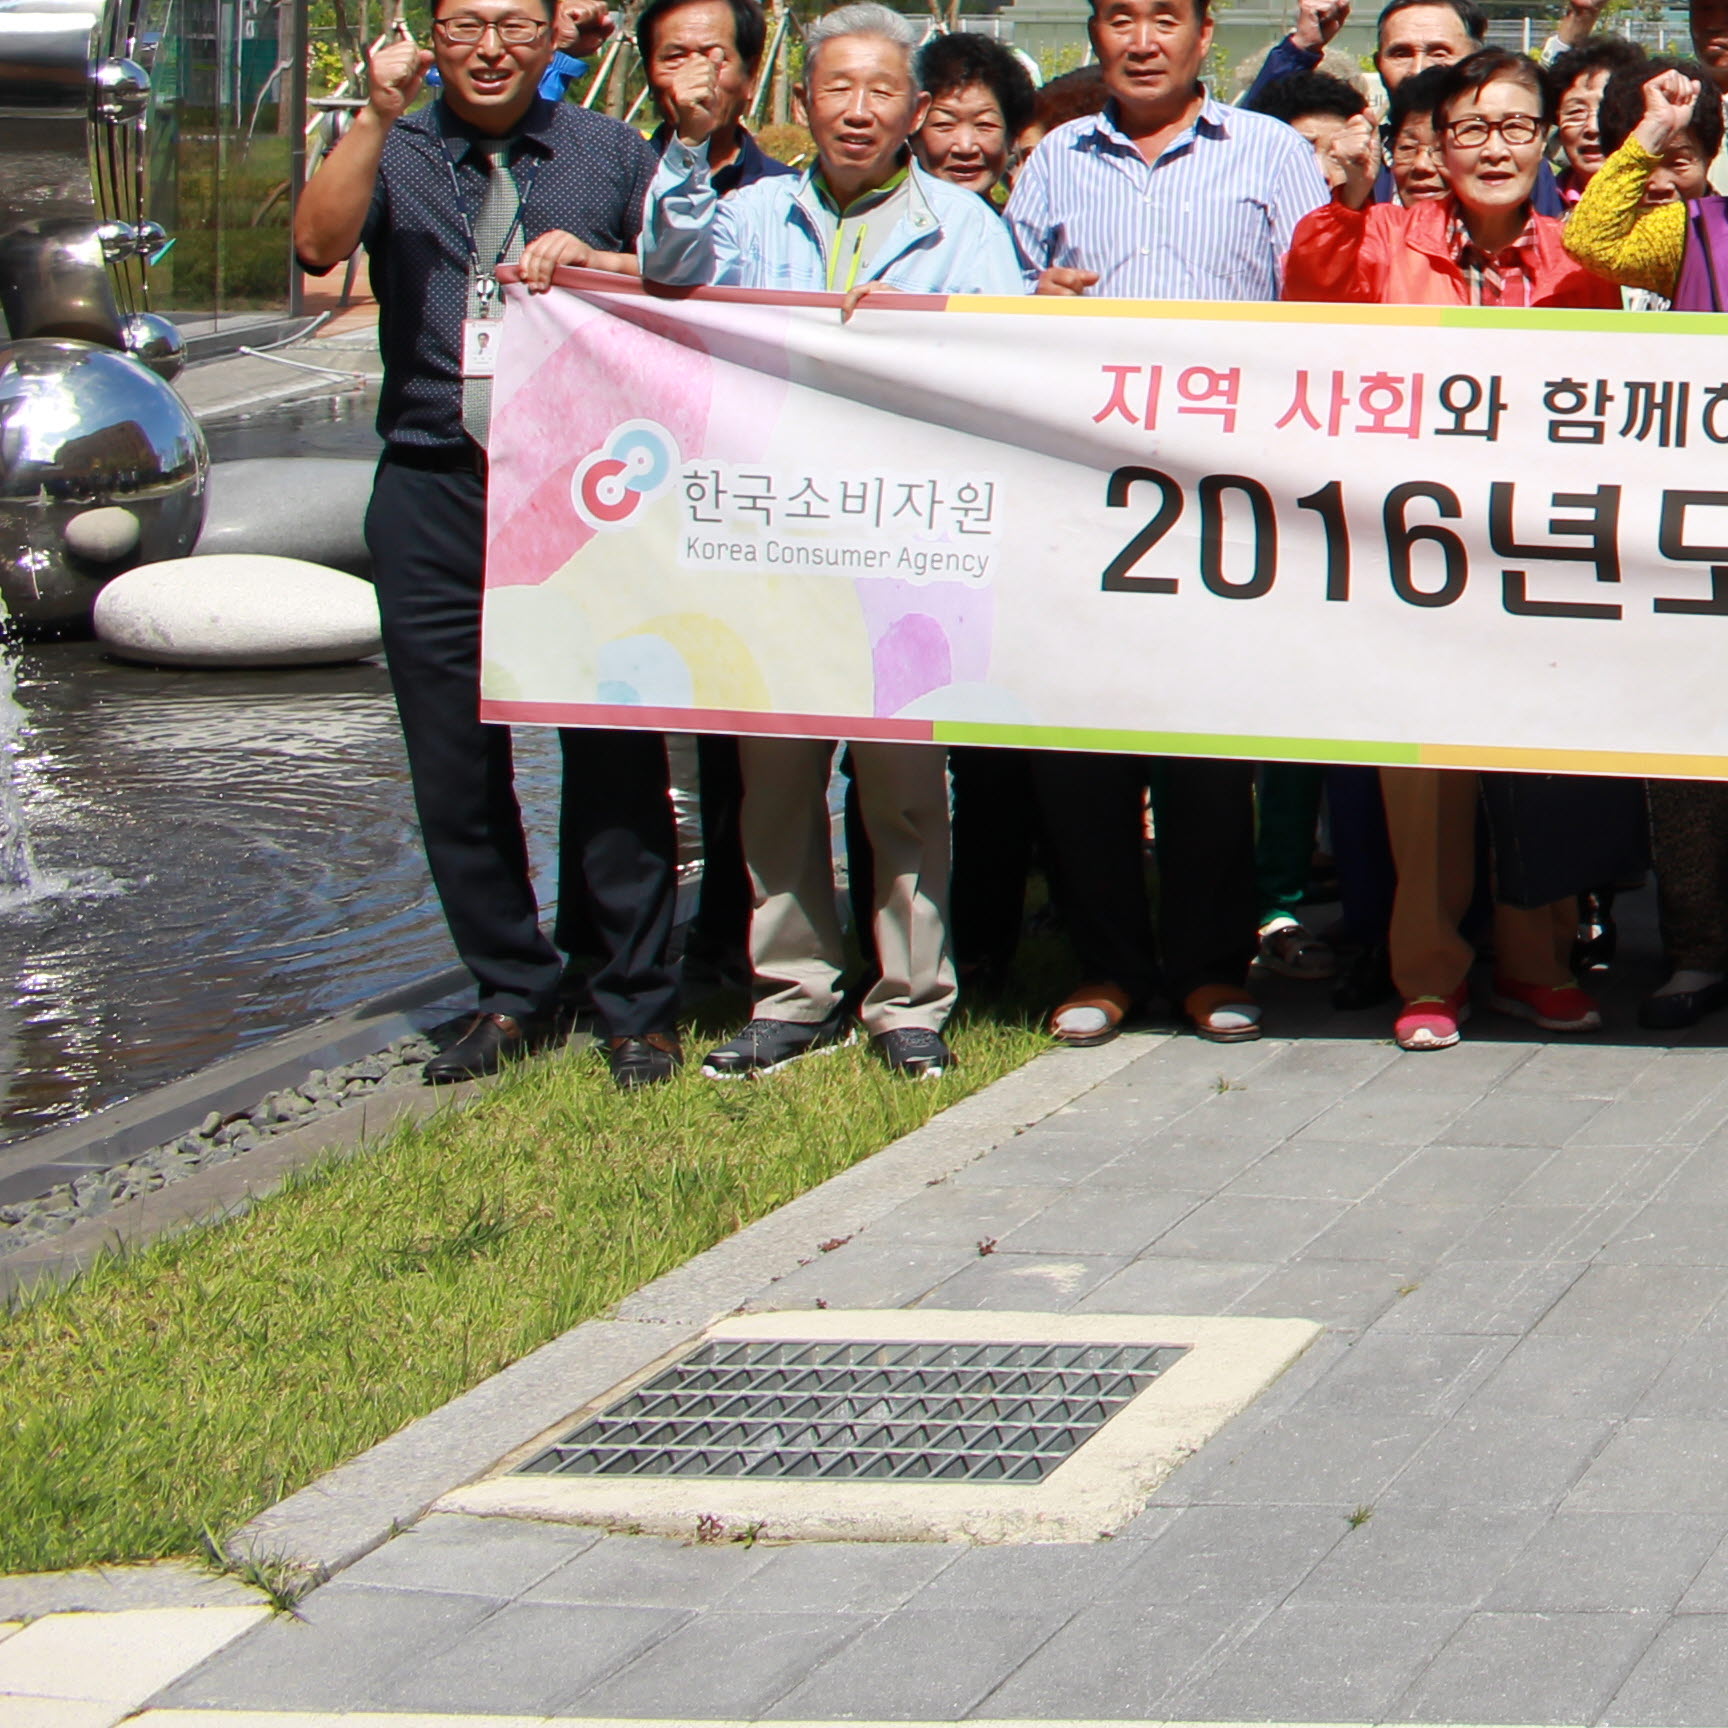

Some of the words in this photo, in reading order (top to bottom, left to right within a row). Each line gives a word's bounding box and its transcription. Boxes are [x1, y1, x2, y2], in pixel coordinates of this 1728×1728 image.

[1092, 364, 1242, 434] 지역
[1277, 370, 1509, 442] 사회와
[683, 470, 994, 535] 한국소비자원
[687, 536, 757, 562] Korea
[766, 540, 891, 568] Consumer
[897, 546, 990, 578] Agency
